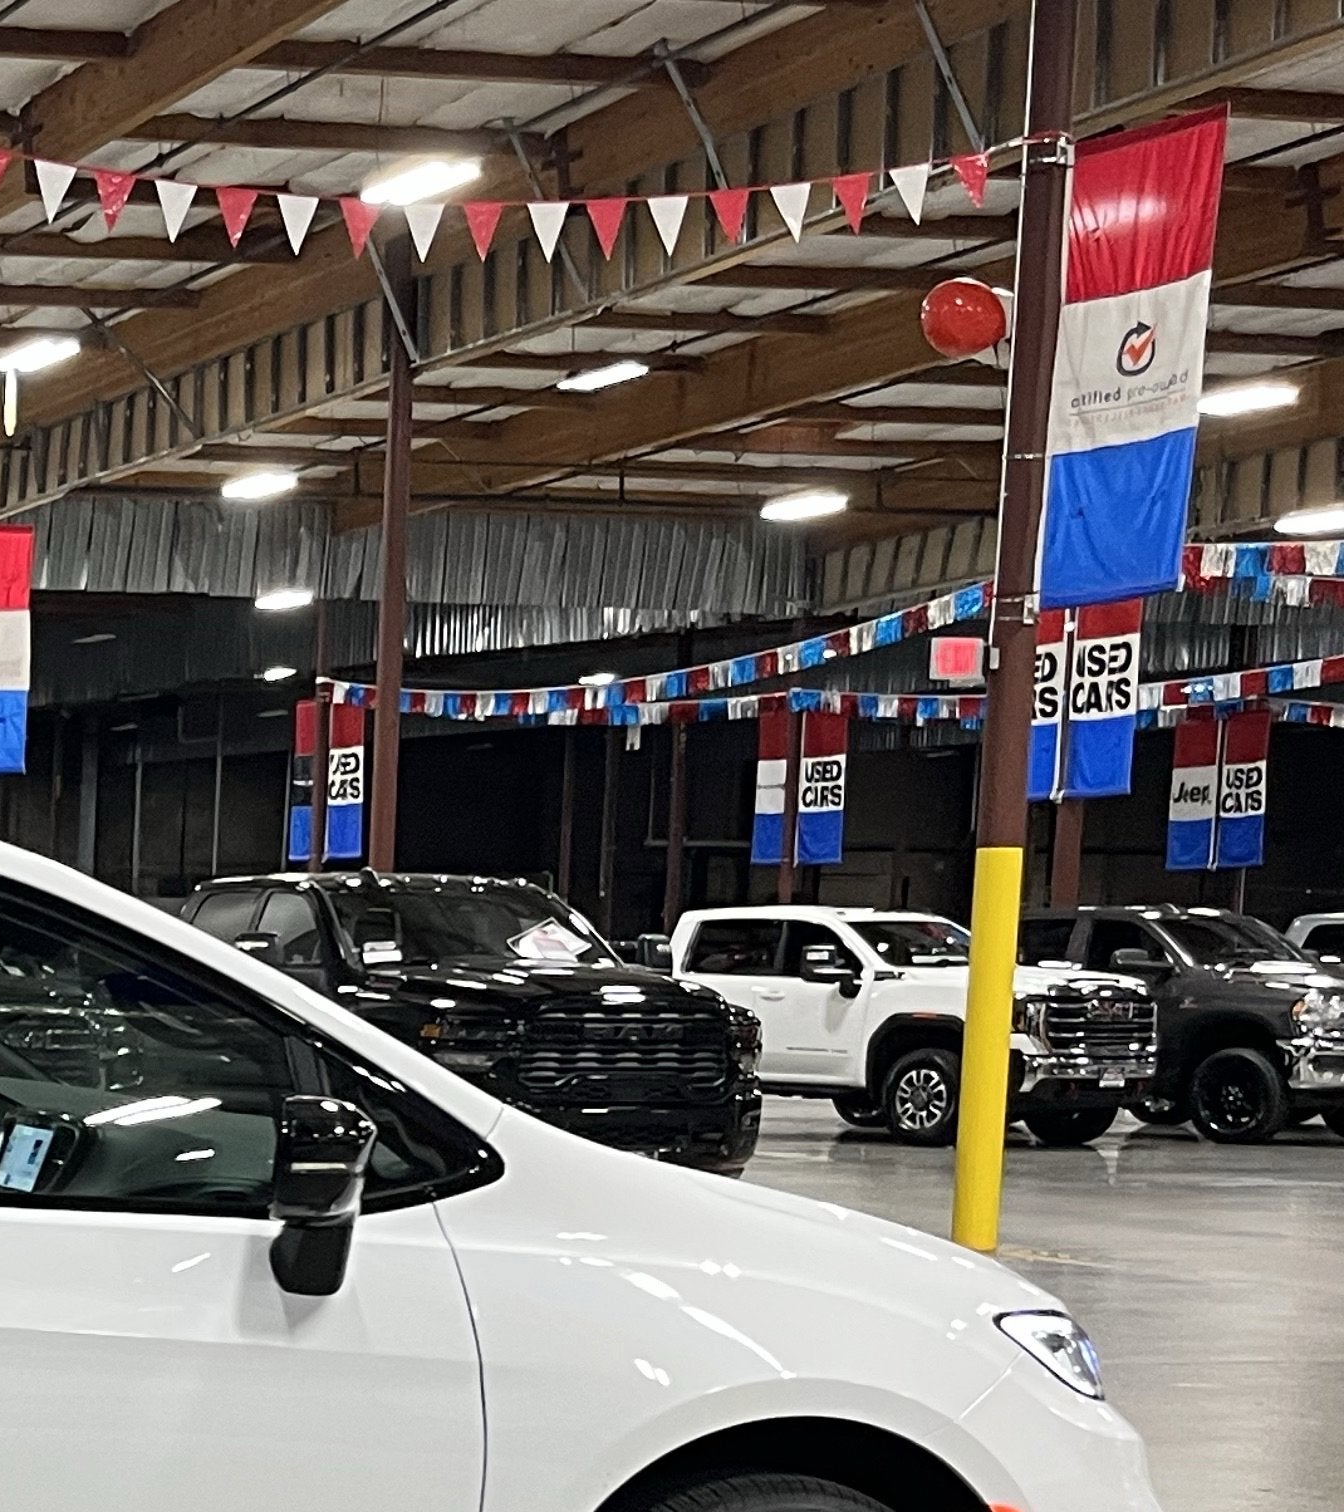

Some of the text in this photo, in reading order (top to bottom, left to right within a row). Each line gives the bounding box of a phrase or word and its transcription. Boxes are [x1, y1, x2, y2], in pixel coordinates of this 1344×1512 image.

[1033, 651, 1058, 684] ED
[1076, 641, 1132, 678] USED
[1072, 677, 1131, 714] CARS
[805, 760, 842, 783] USED
[1225, 766, 1263, 790] USED
[802, 784, 842, 808] CARS
